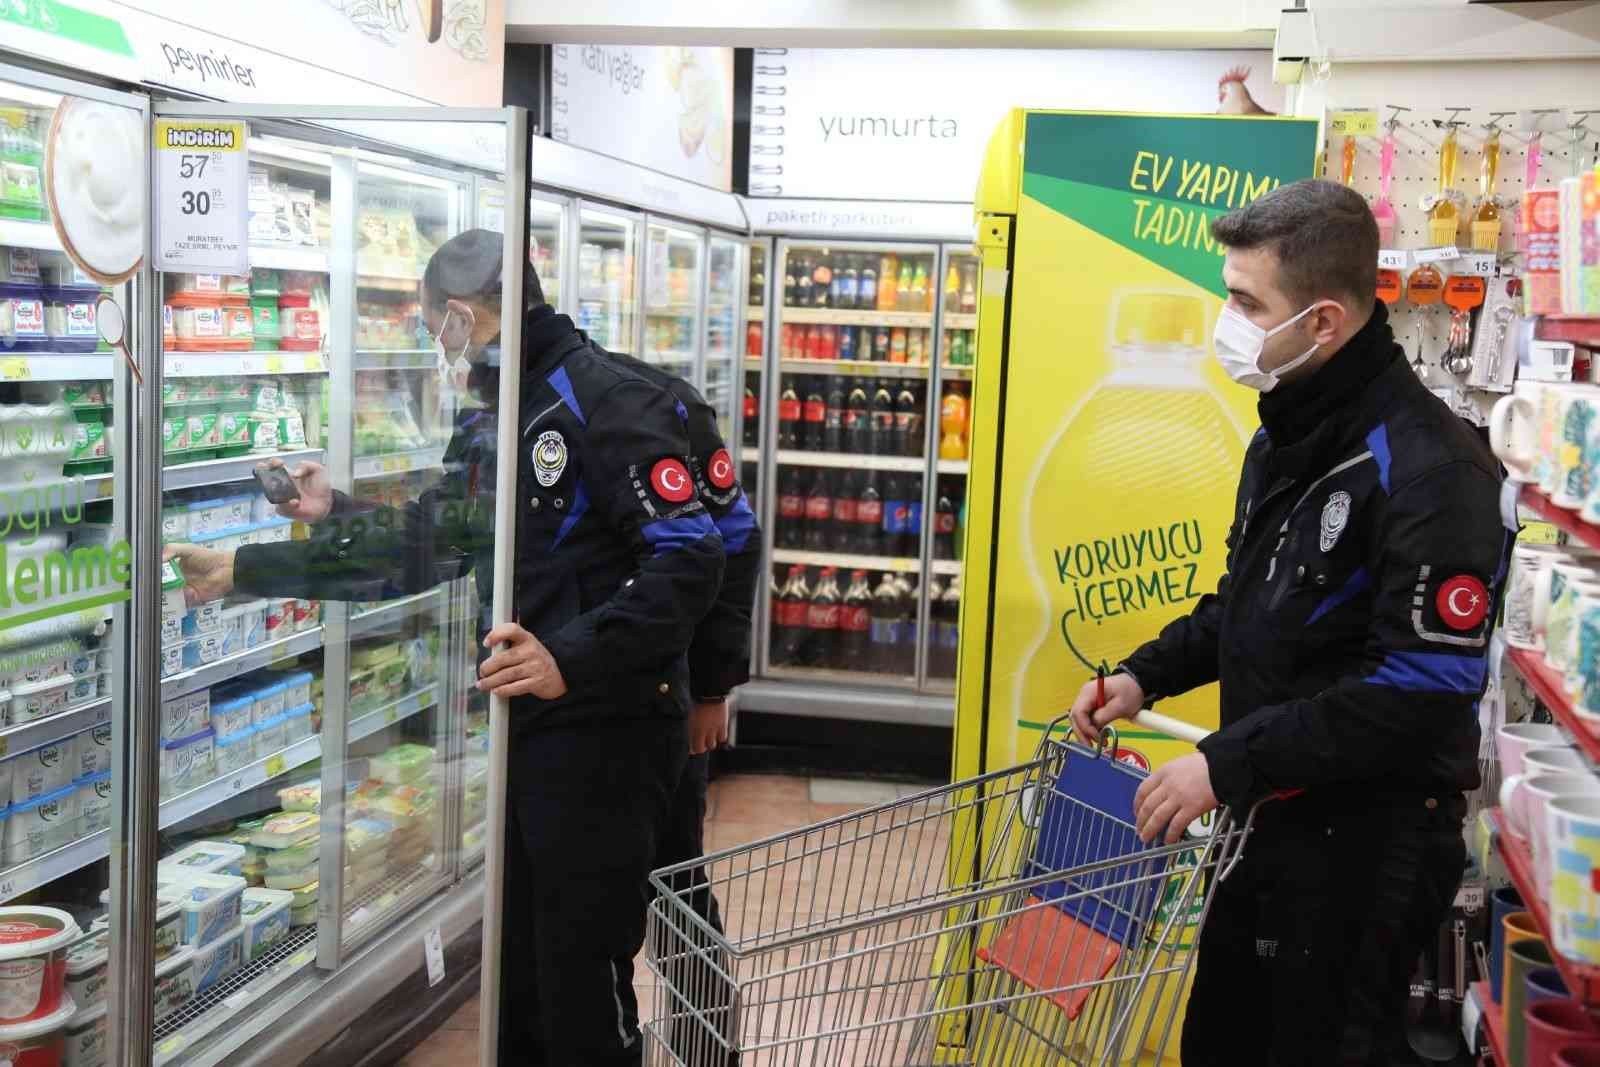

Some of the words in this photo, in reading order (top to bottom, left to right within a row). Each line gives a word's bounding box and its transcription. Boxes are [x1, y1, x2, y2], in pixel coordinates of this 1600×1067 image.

[160, 42, 256, 88] peynirler
[166, 127, 235, 149] İNDİRİM
[819, 114, 959, 142] yumurta
[180, 154, 209, 178] 57
[1130, 151, 1174, 193] EV
[182, 190, 210, 215] 30
[767, 209, 827, 225] paketli
[1133, 199, 1228, 257] TADIN
[1474, 261, 1489, 272] 15
[1054, 519, 1202, 585] KORUYUCU
[1073, 562, 1202, 626] İÇERMEZ
